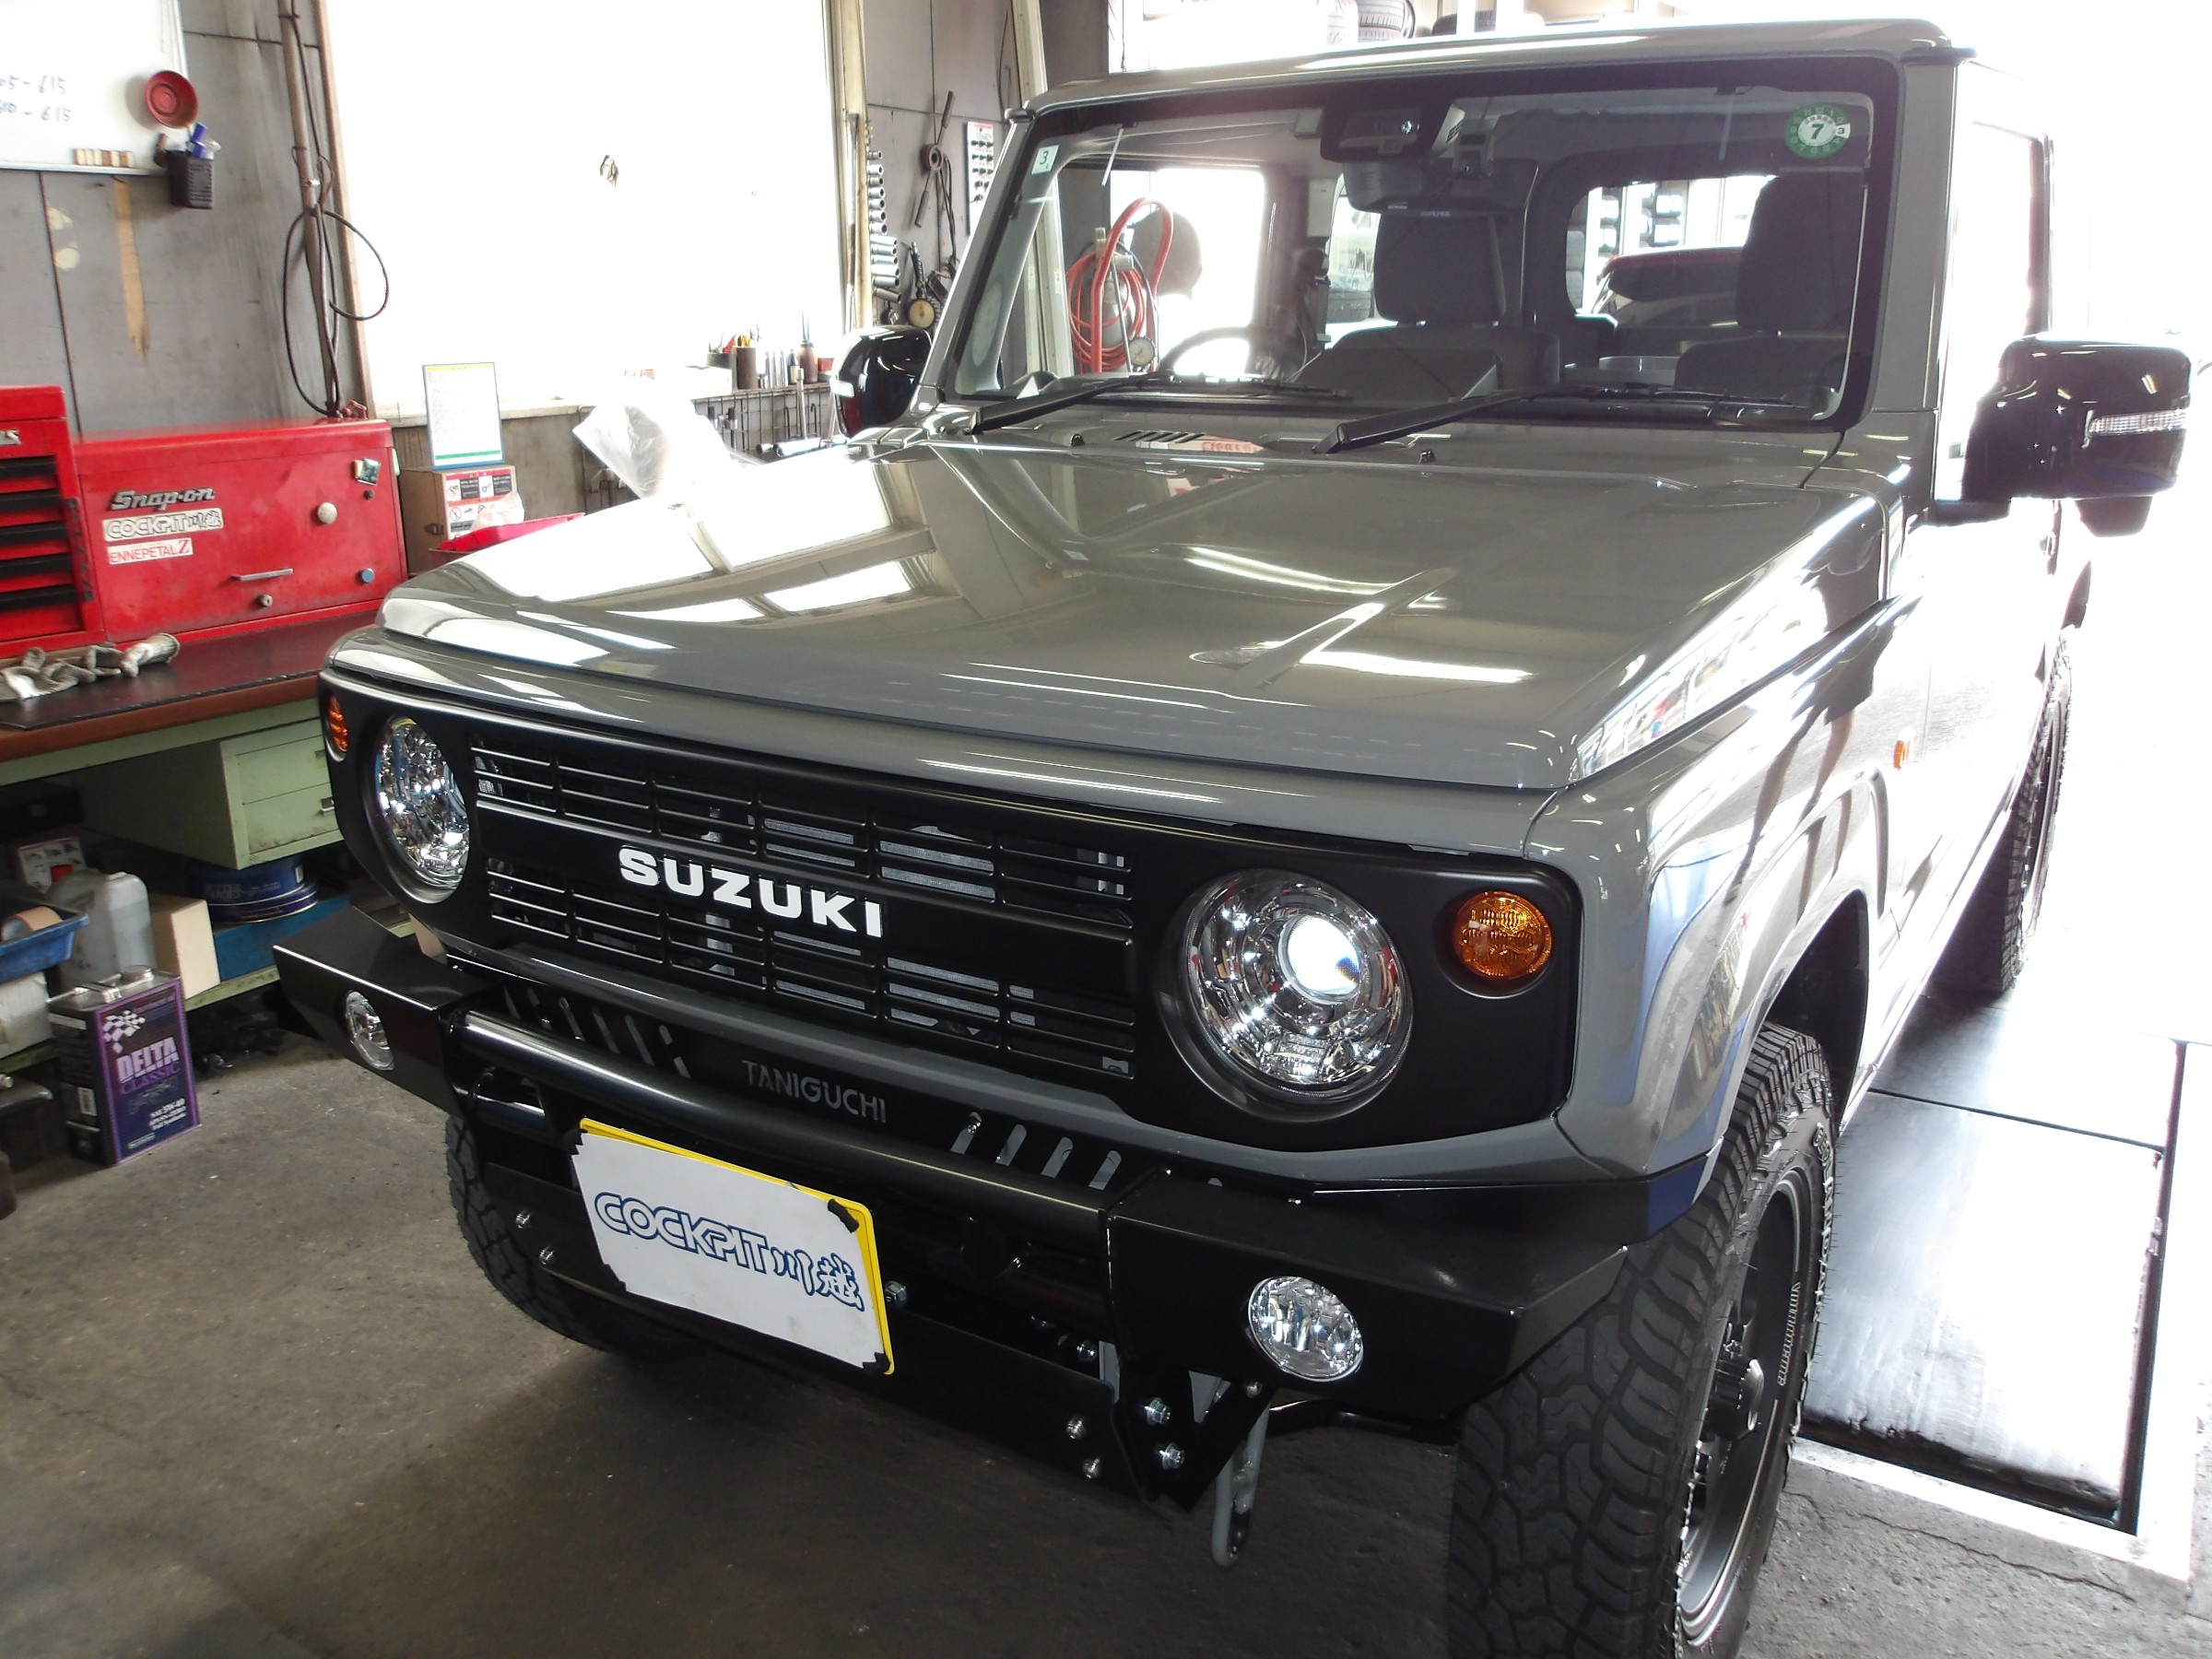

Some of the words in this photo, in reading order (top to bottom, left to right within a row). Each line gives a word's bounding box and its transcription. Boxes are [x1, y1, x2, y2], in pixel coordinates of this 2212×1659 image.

[1811, 123, 1824, 139] 7
[1040, 150, 1049, 165] 3
[109, 488, 215, 512] Snap-on
[110, 546, 178, 563] ENNEPETAL
[618, 847, 882, 938] SUZUKI
[116, 1037, 180, 1084] DELTA
[121, 1062, 181, 1095] CLASSIC
[742, 1059, 886, 1124] TANIGUCHI
